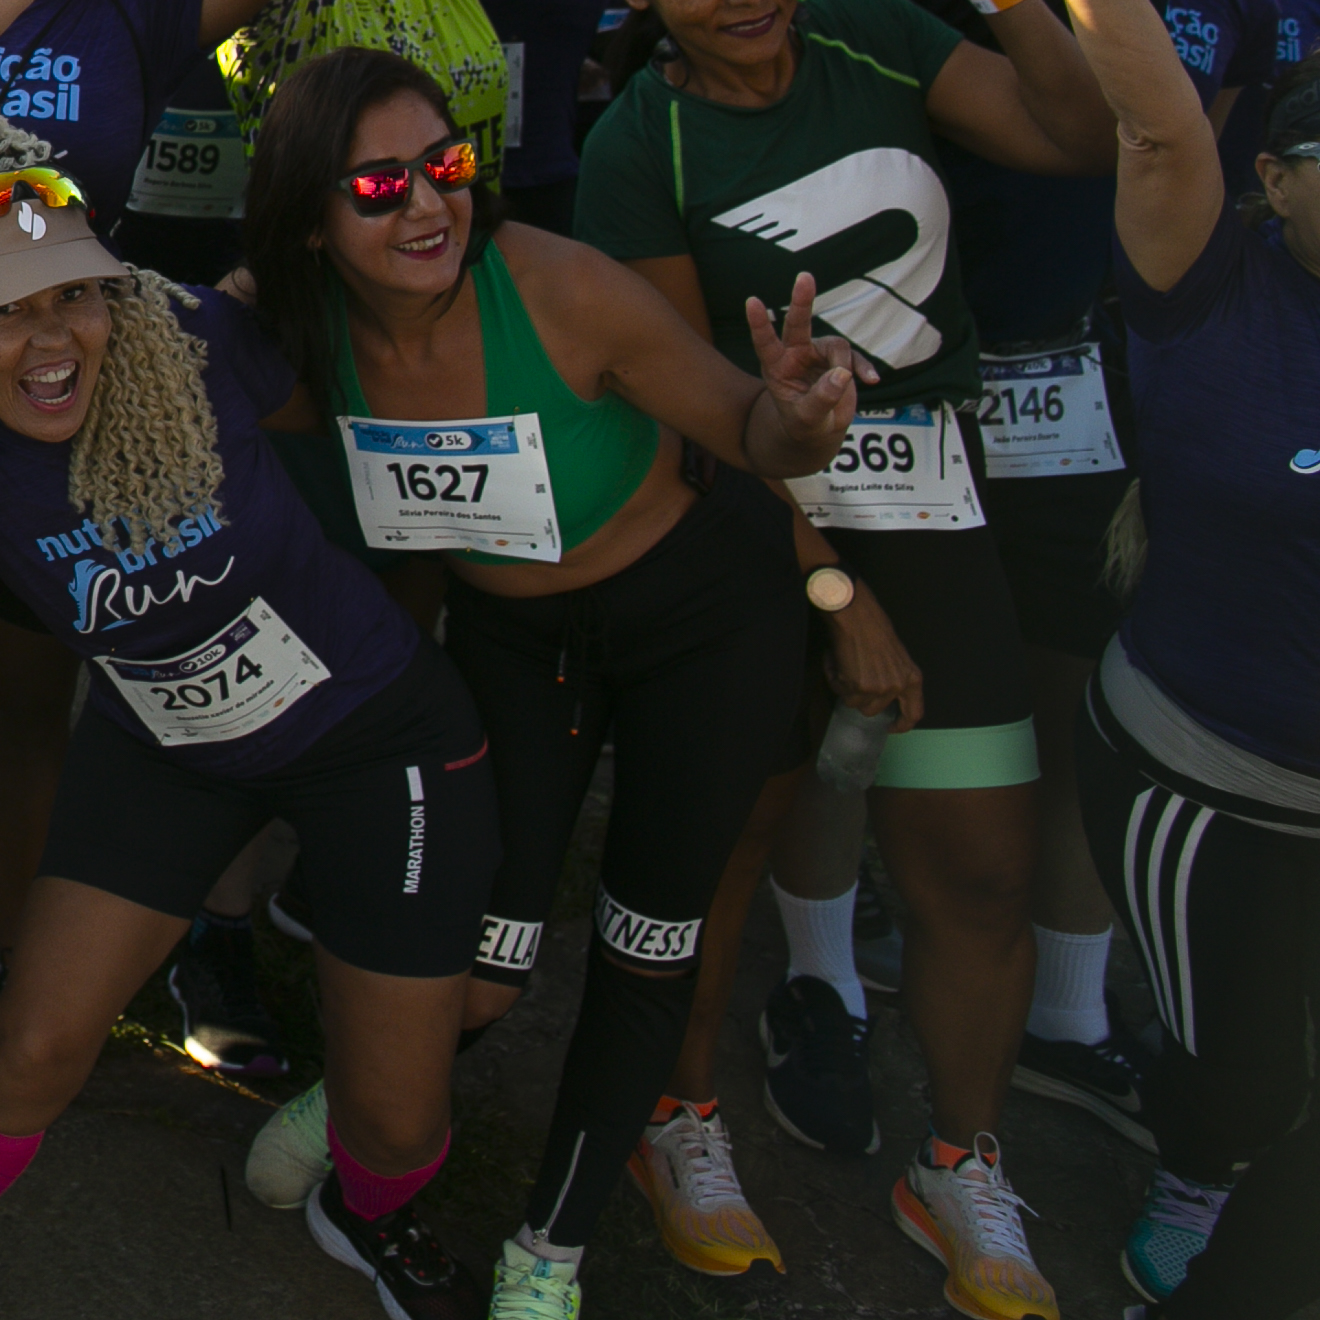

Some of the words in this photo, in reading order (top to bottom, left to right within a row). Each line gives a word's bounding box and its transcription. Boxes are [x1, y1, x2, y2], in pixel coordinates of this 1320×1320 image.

[145, 139, 220, 174] 1589
[978, 384, 1065, 427] 2146
[445, 434, 464, 447] 5k
[822, 432, 915, 475] 569
[386, 462, 489, 503] 1627
[398, 508, 422, 518] Silvia
[423, 508, 455, 519] Pereira
[456, 511, 472, 520] dos
[473, 513, 502, 522] Santos
[77, 555, 235, 635] Run
[196, 648, 222, 667] 10k
[149, 653, 263, 711] 2074
[402, 804, 425, 894] MARATHON
